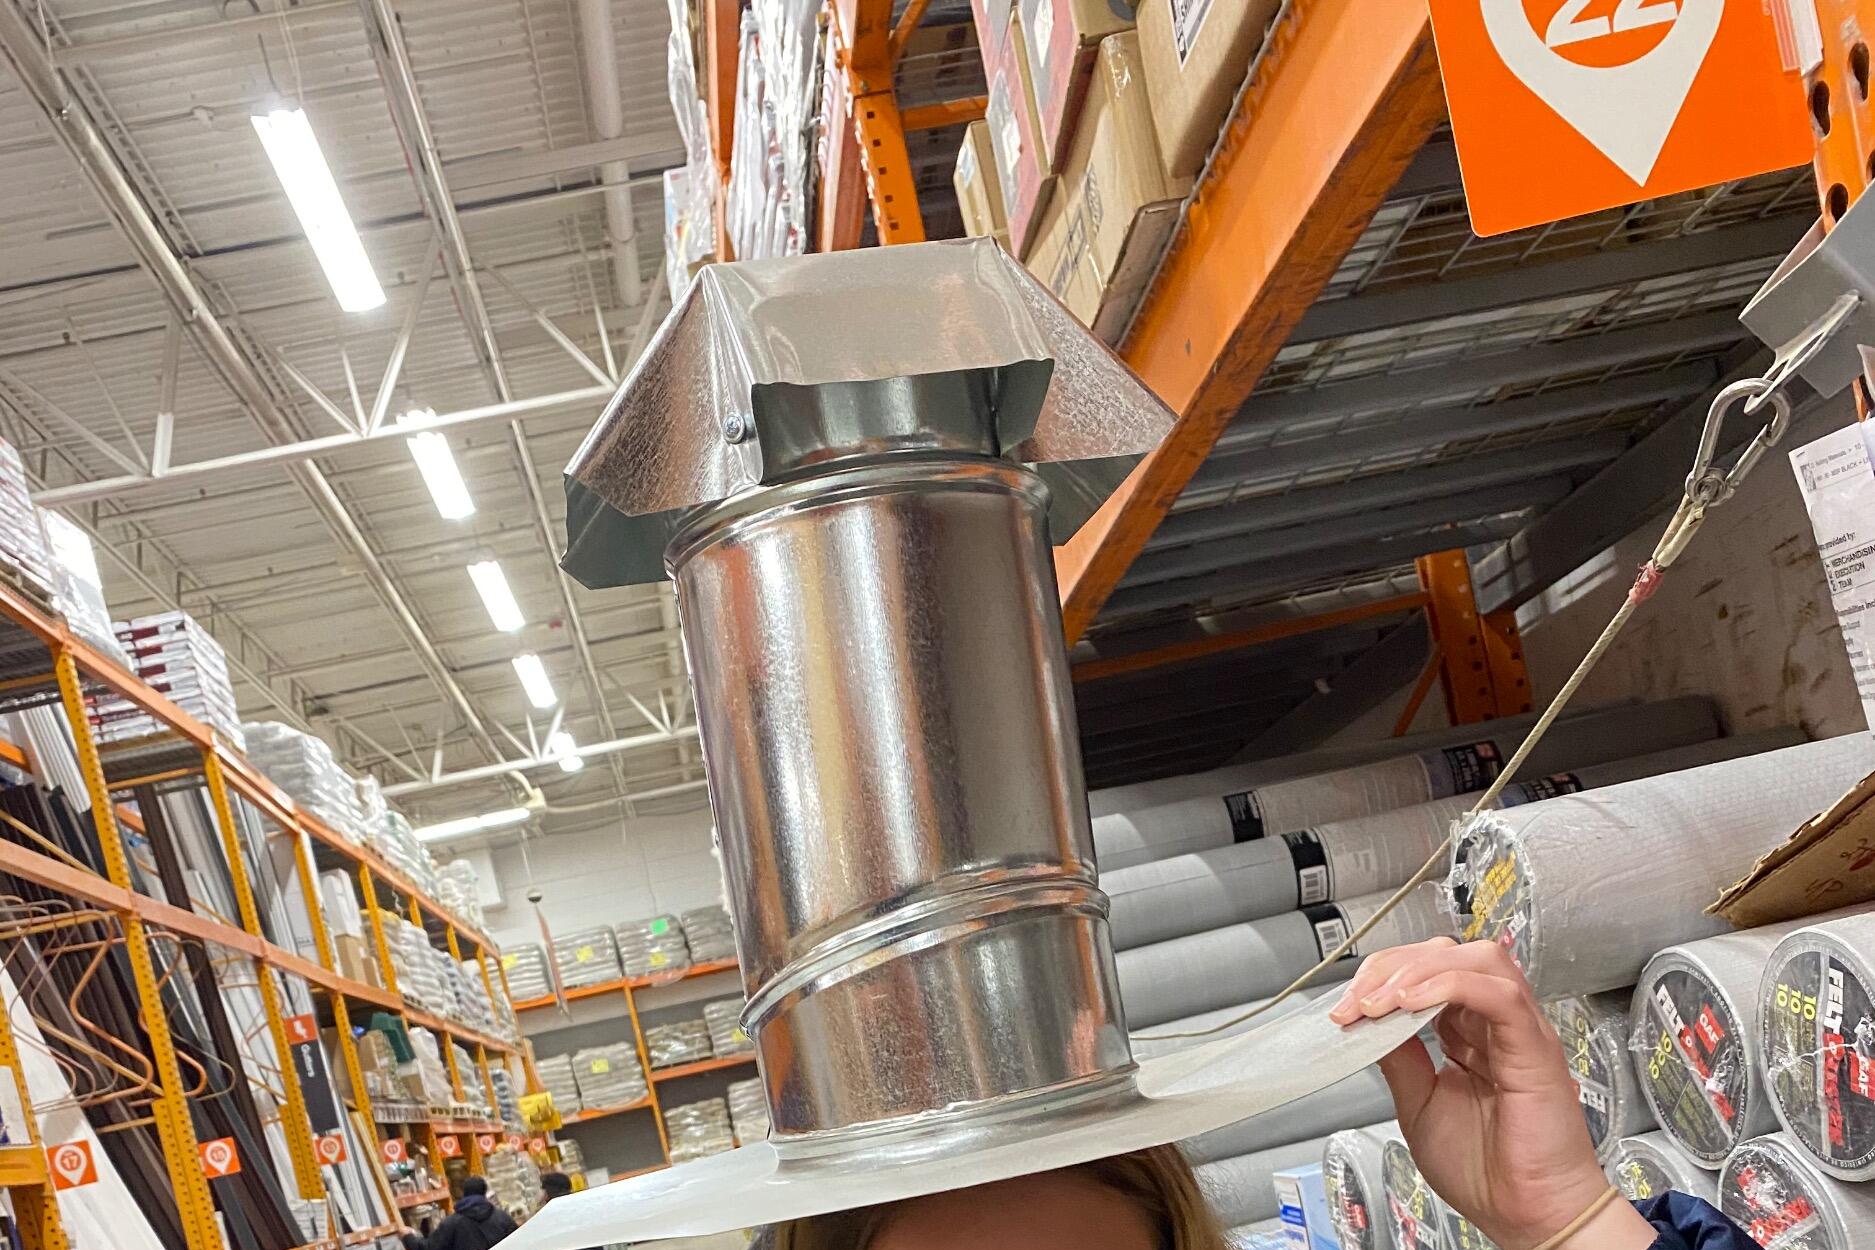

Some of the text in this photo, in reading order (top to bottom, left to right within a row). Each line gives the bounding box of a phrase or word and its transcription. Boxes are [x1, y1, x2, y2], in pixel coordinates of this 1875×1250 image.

[1777, 984, 1789, 1008] 10
[1790, 989, 1802, 1014] 10
[1804, 996, 1817, 1021] 10
[1824, 967, 1844, 1035] FELT
[1656, 983, 1685, 1036] FELT
[1699, 1013, 1720, 1045] GAF
[63, 1151, 79, 1169] 17
